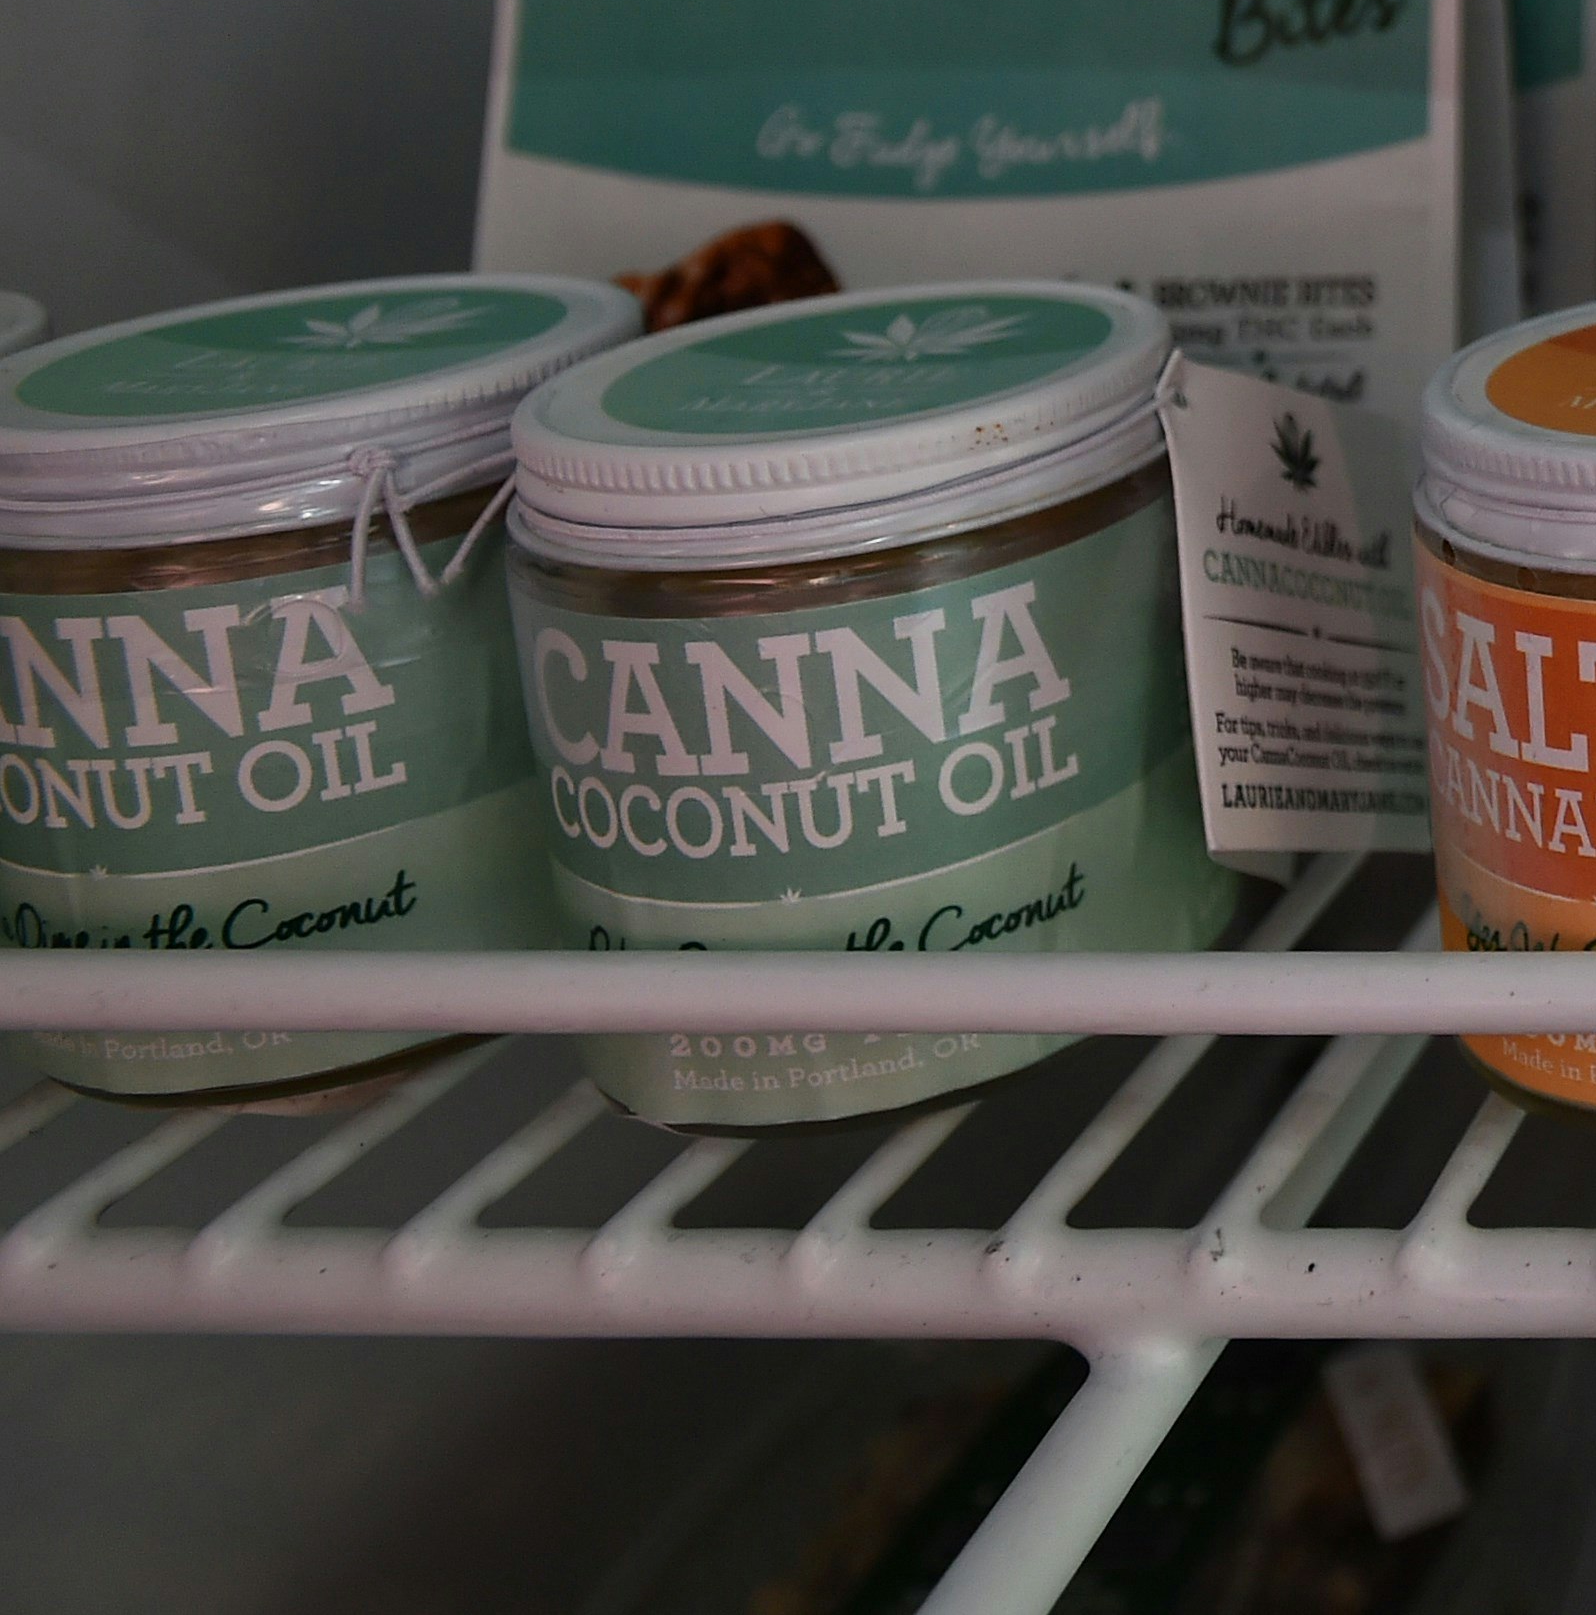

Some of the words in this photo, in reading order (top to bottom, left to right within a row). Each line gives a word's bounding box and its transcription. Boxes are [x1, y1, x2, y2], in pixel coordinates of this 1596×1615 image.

[0, 585, 396, 749] NNA
[534, 580, 1071, 777] CANNA
[1215, 712, 1238, 734] For
[1218, 745, 1249, 767] your
[0, 750, 214, 830] ONUT
[237, 720, 407, 813] OIL
[551, 759, 916, 860] COCONUT
[937, 716, 1080, 816] OIL
[221, 869, 417, 950] Coconut
[918, 862, 1085, 952] Coconut
[104, 1032, 236, 1062] Portland,
[669, 1033, 828, 1059] 200MG
[672, 1069, 745, 1092] Made
[752, 1069, 778, 1091] in
[788, 1049, 926, 1091] Portland,
[932, 1033, 982, 1060] OR
[1502, 1038, 1554, 1073] Made
[1560, 1055, 1582, 1081] in
